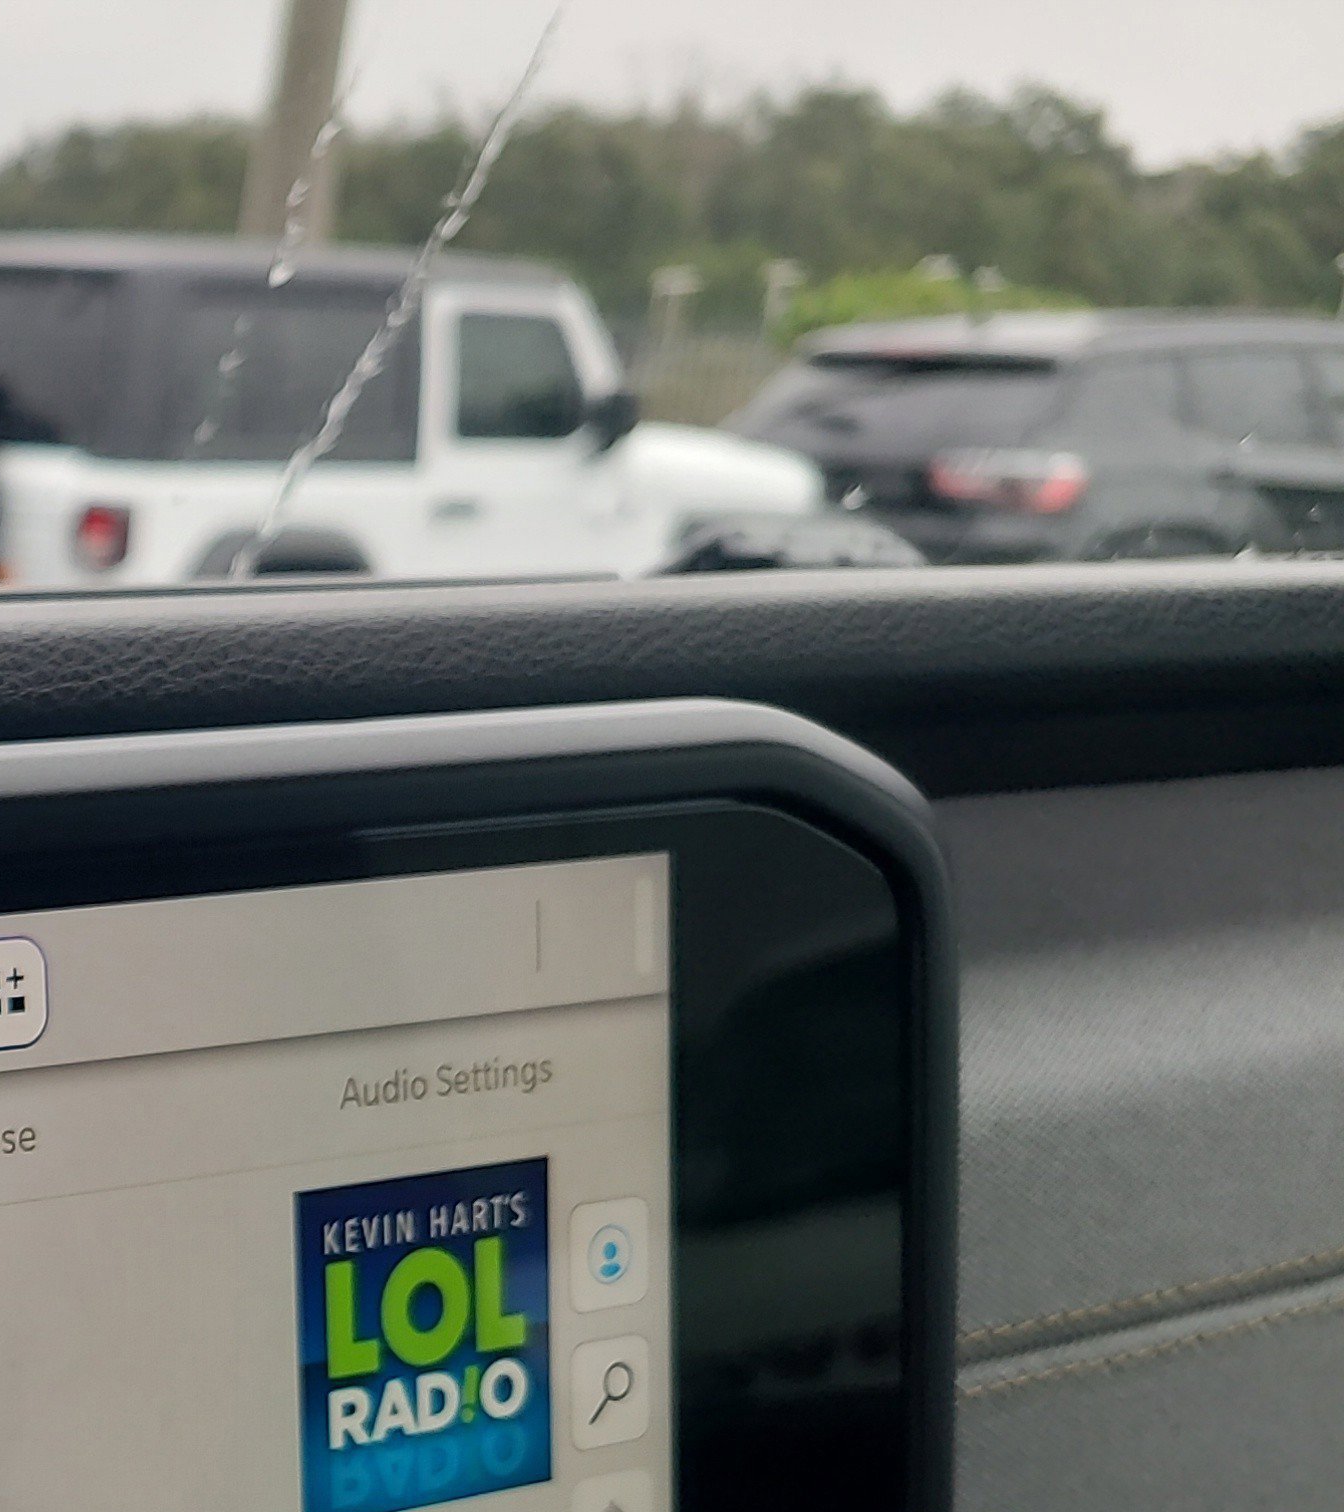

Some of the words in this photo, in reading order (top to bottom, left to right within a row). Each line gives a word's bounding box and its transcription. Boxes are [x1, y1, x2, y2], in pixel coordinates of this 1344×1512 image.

[339, 1063, 429, 1111] Audio
[435, 1053, 554, 1099] Settings
[323, 1209, 414, 1255] KEVIN
[325, 1236, 527, 1380] LOL
